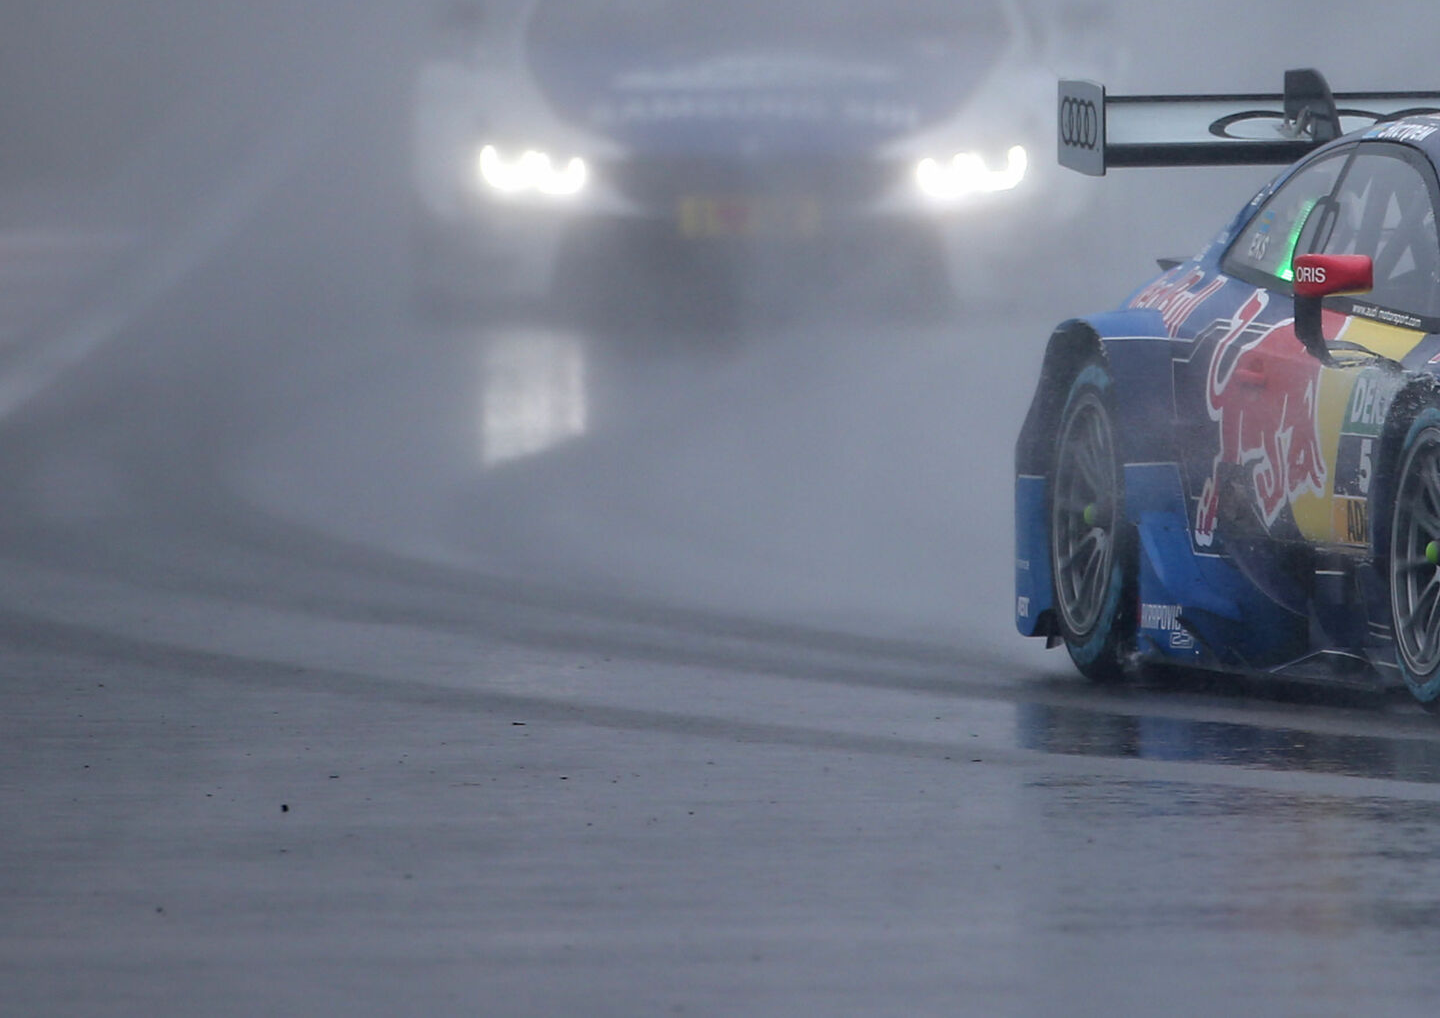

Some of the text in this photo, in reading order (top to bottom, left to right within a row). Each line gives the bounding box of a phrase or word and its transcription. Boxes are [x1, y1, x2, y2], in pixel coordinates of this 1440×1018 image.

[1296, 267, 1326, 283] ORIS
[1351, 378, 1387, 425] DEK
[1347, 500, 1369, 542] AD
